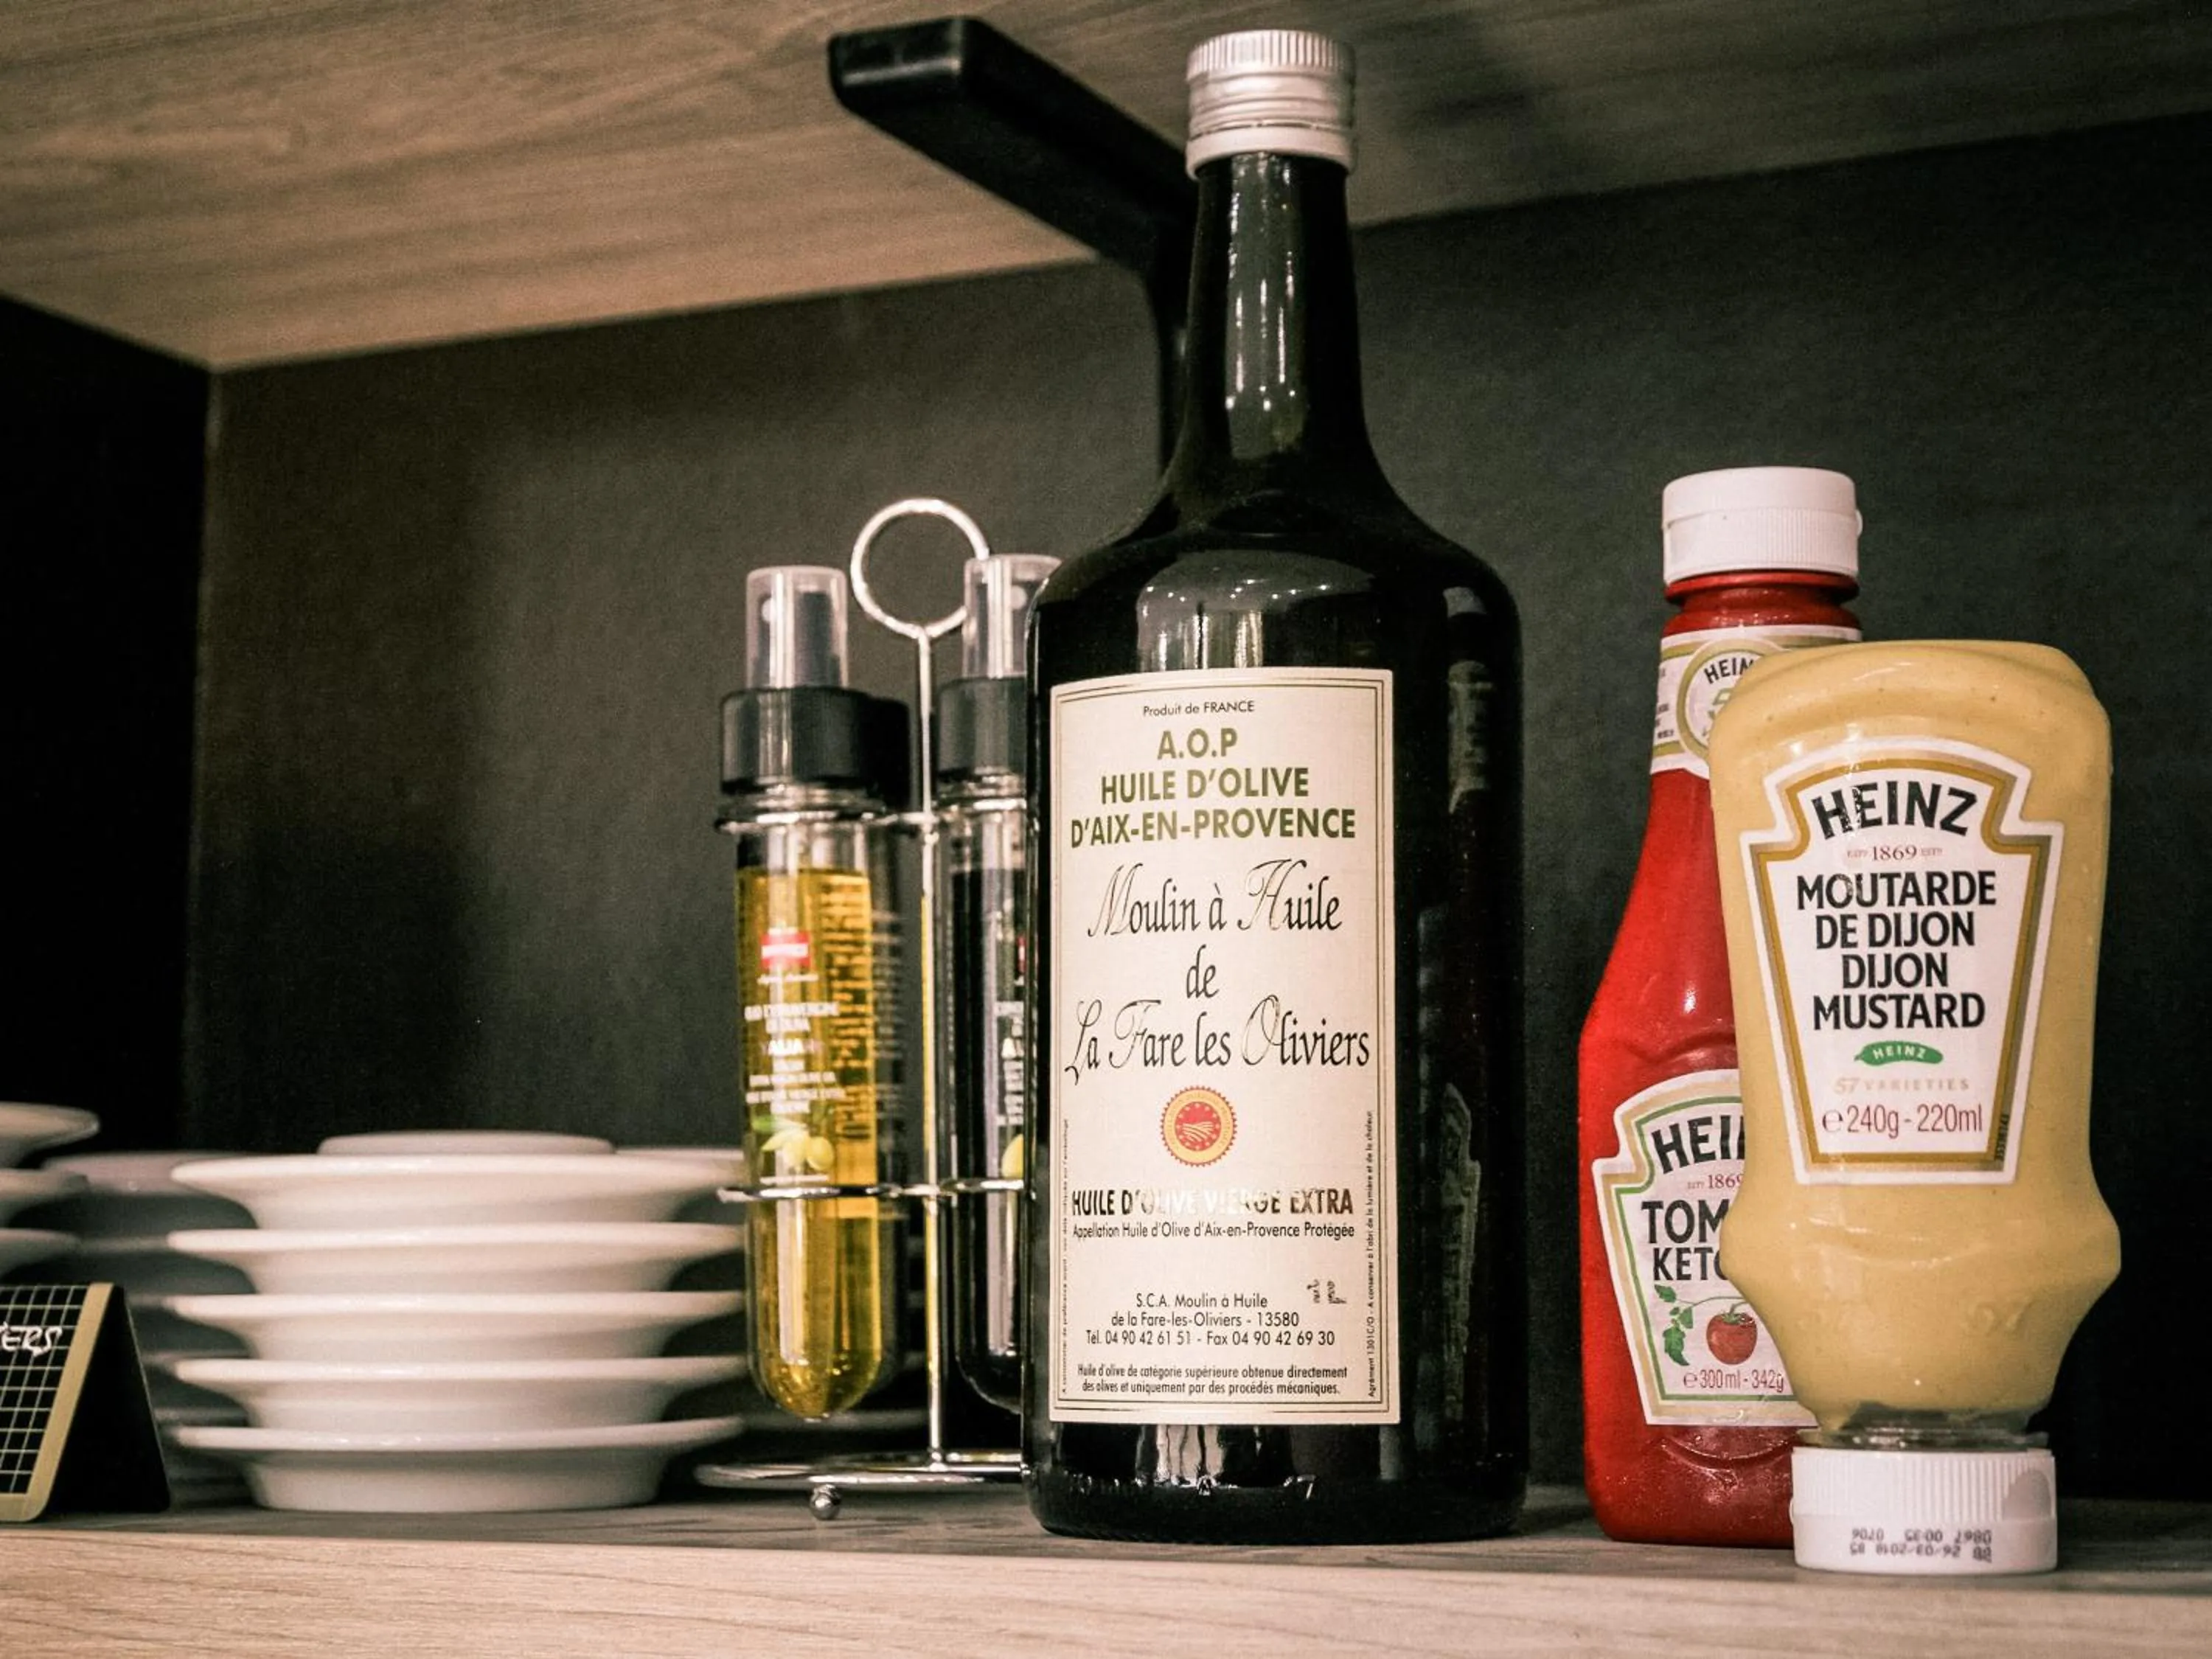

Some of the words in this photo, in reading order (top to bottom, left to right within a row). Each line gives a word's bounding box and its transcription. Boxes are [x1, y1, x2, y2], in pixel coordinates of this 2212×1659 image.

[1144, 705, 1181, 716] Produit
[1185, 703, 1200, 714] de
[1204, 700, 1254, 712] FRANCE
[1158, 728, 1237, 759] A.O.P
[1102, 771, 1175, 804] HUILE
[1188, 767, 1309, 798] D'OLIVE
[1810, 781, 1978, 839] HEINZ
[1071, 807, 1356, 849] D'AIX-EN-PROVENCE
[1872, 844, 1917, 861] 1869
[1088, 863, 1200, 937] Moulin
[1208, 882, 1227, 931] à
[1238, 859, 1343, 931] Huile
[1798, 871, 1997, 910] MOUTARDE
[1816, 914, 1857, 948] DE
[1868, 912, 1975, 947] DIJON
[1186, 945, 1219, 998] de
[1842, 953, 1948, 989] DIJON
[1813, 992, 1985, 1029] MUSTARD
[1065, 1000, 1100, 1085] La
[1109, 1000, 1186, 1068] Fare
[1196, 1012, 1231, 1065] les
[1242, 995, 1369, 1066] Oliviers
[1873, 1046, 1927, 1059] HEINZ
[1864, 1079, 1969, 1091] VARIETIES
[1917, 1104, 1982, 1133] 220ml
[1072, 1189, 1115, 1216] HUILE
[1290, 1189, 1354, 1214] EXTRA
[1366, 1176, 1374, 1205] lumière
[1073, 1222, 1119, 1240] Appellation
[1122, 1222, 1147, 1237] Huile
[1152, 1221, 1190, 1237] d'Olive
[1194, 1221, 1300, 1237] d'Aix-en-Provence
[1366, 1218, 1374, 1228] de
[1175, 1293, 1217, 1307] Moulin
[1234, 1293, 1267, 1308] Huile
[1111, 1312, 1124, 1326] de
[1128, 1312, 1137, 1326] la
[1141, 1312, 1242, 1326] Fare-les-Oliviers
[1258, 1312, 1299, 1327] 13580
[0, 1321, 62, 1356] ERS
[1105, 1330, 1118, 1345] 04
[1122, 1330, 1135, 1345] 90
[1139, 1330, 1152, 1345] 42
[1158, 1331, 1170, 1345] 61
[1178, 1331, 1190, 1345] 51
[1207, 1331, 1228, 1345] Fax
[1233, 1331, 1248, 1345] 04
[1253, 1331, 1270, 1345] 90
[1276, 1331, 1291, 1345] 42
[1297, 1330, 1313, 1346] 69
[1318, 1331, 1335, 1346] 30
[1078, 1363, 1096, 1376] Huile
[1127, 1364, 1138, 1377] de
[1185, 1366, 1239, 1382] supérieure
[1242, 1365, 1284, 1378] obtenue
[1287, 1365, 1347, 1378] directement
[1367, 1357, 1376, 1397] Agrément
[1752, 1371, 1784, 1392] 342g
[1082, 1379, 1094, 1391] des
[1096, 1379, 1118, 1392] olives
[1121, 1382, 1129, 1392] et
[1131, 1380, 1186, 1395] uniquement
[1189, 1384, 1206, 1396] par
[1208, 1380, 1225, 1394] des
[1228, 1380, 1273, 1396] procédés
